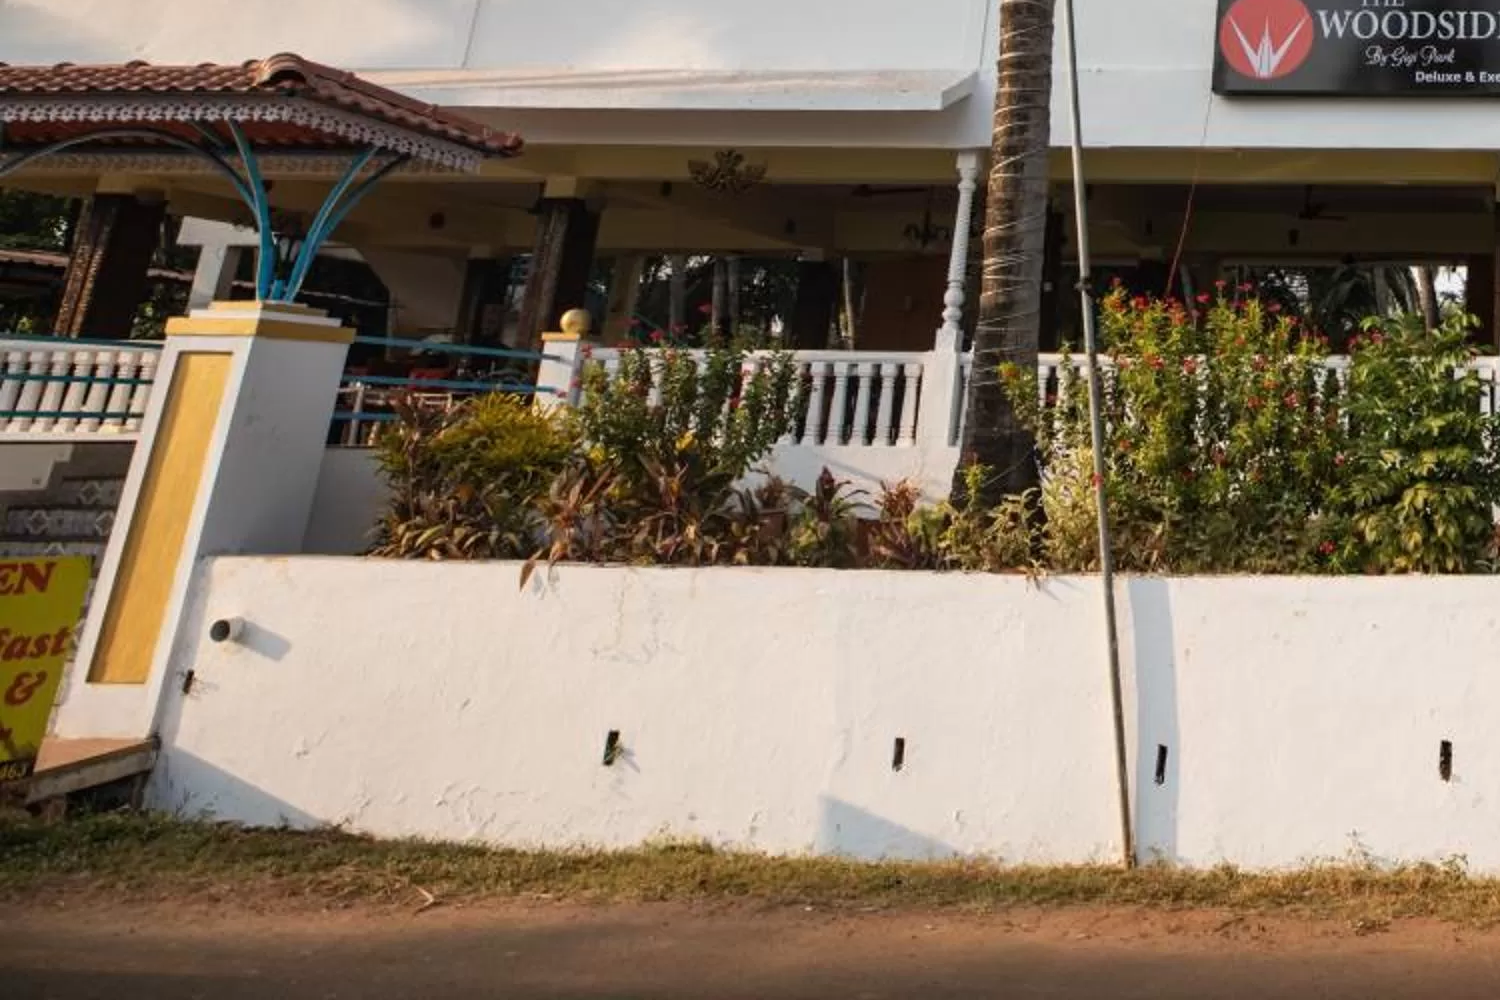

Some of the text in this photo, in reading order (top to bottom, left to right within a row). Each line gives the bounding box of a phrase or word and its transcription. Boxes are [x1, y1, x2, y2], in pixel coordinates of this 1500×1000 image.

[1364, 45, 1388, 67] By
[1420, 45, 1455, 67] Park
[1415, 71, 1461, 83] Deluxe
[1465, 71, 1475, 83] &
[5, 671, 47, 706] &
